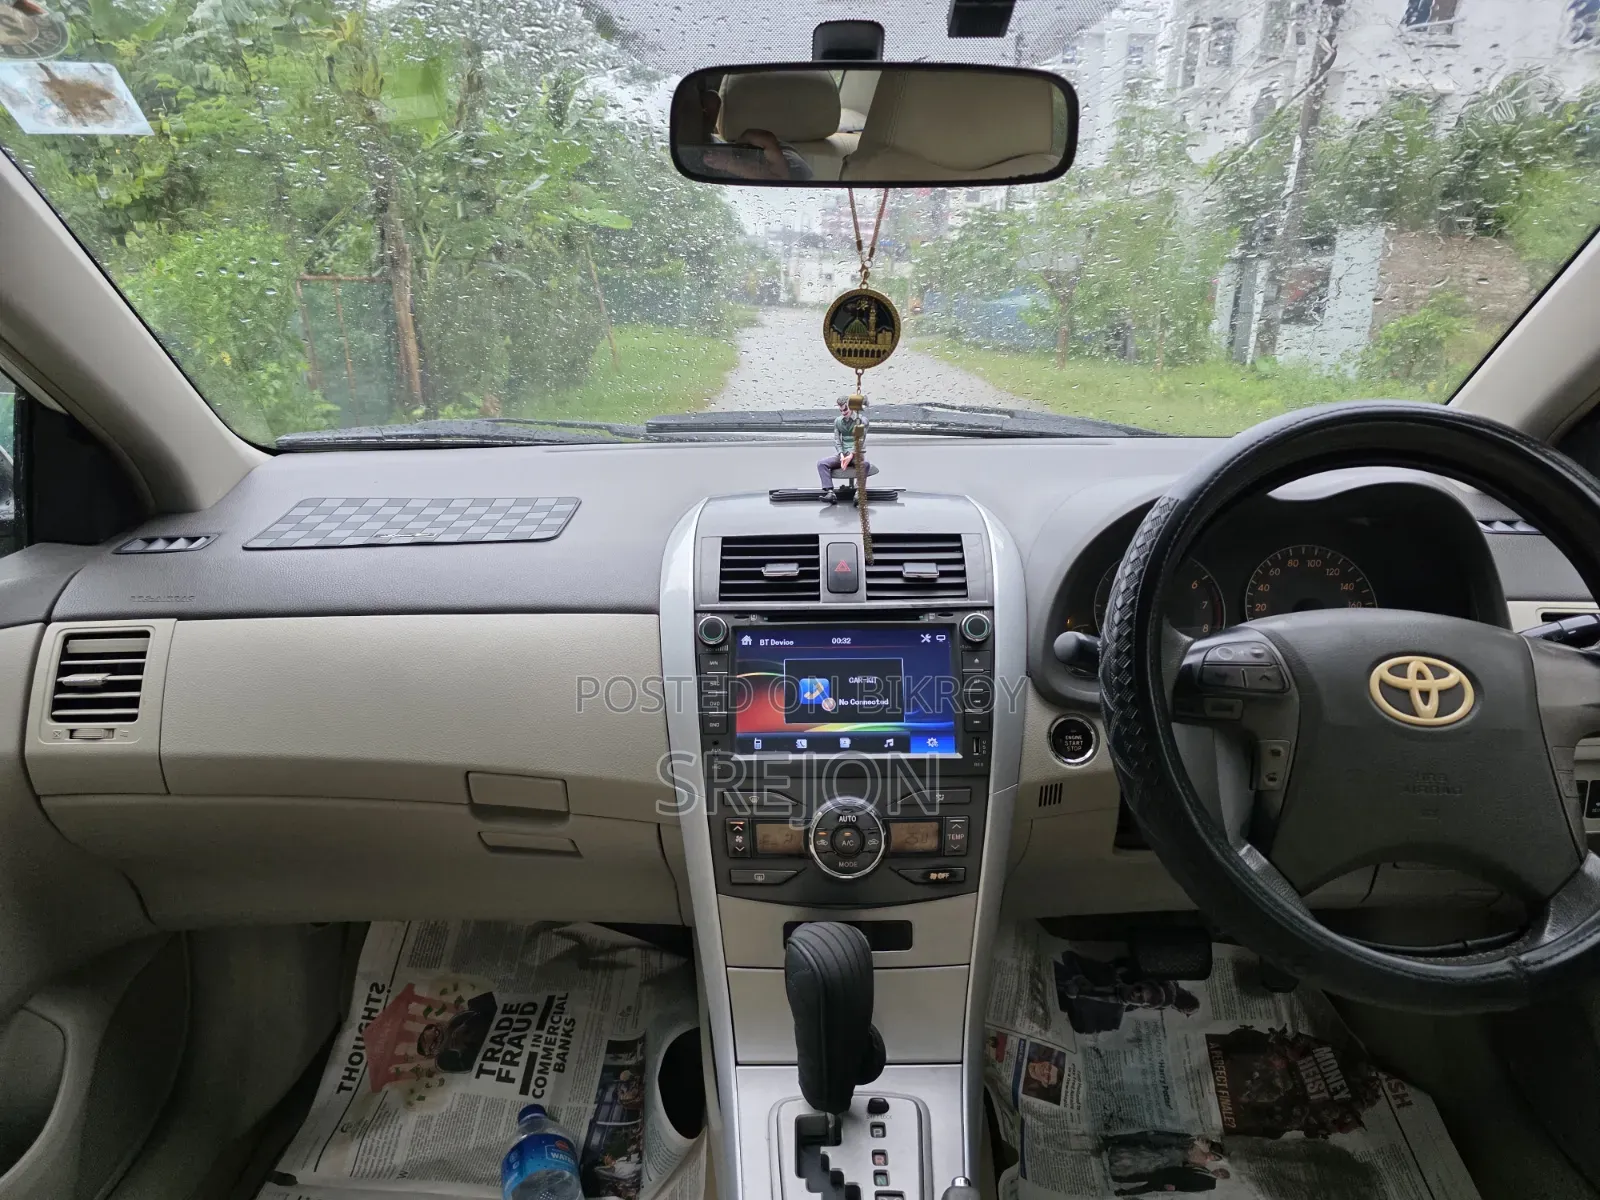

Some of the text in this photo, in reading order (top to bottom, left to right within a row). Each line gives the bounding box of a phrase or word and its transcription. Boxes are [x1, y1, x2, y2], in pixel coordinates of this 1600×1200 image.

[1269, 568, 1281, 576] 60
[1326, 568, 1340, 576] 120
[1191, 579, 1198, 590] 6
[1257, 584, 1270, 592] 40
[1340, 583, 1354, 591] 140
[1201, 600, 1208, 610] 7
[1255, 604, 1266, 612] 20
[1202, 623, 1209, 633] 8
[759, 638, 794, 646] BT Device
[831, 637, 852, 645] 00:32
[839, 698, 889, 706] No Connected
[838, 815, 857, 823] AUTO
[947, 833, 965, 841] TEMP
[841, 839, 855, 847] A/C
[475, 1002, 521, 1079] TRADE
[495, 1001, 539, 1084] FRAUD
[531, 1034, 543, 1048] IN
[532, 992, 569, 1099] COMMERCIAL
[553, 1017, 576, 1073] BANKS
[1210, 1050, 1229, 1089] PERFECT
[1313, 1046, 1351, 1100] MONEY
[1298, 1055, 1330, 1100] HEIST
[1217, 1089, 1237, 1129] FINALE?
[873, 1128, 883, 1136] P
[874, 1155, 885, 1165] R
[877, 1175, 887, 1185] N
